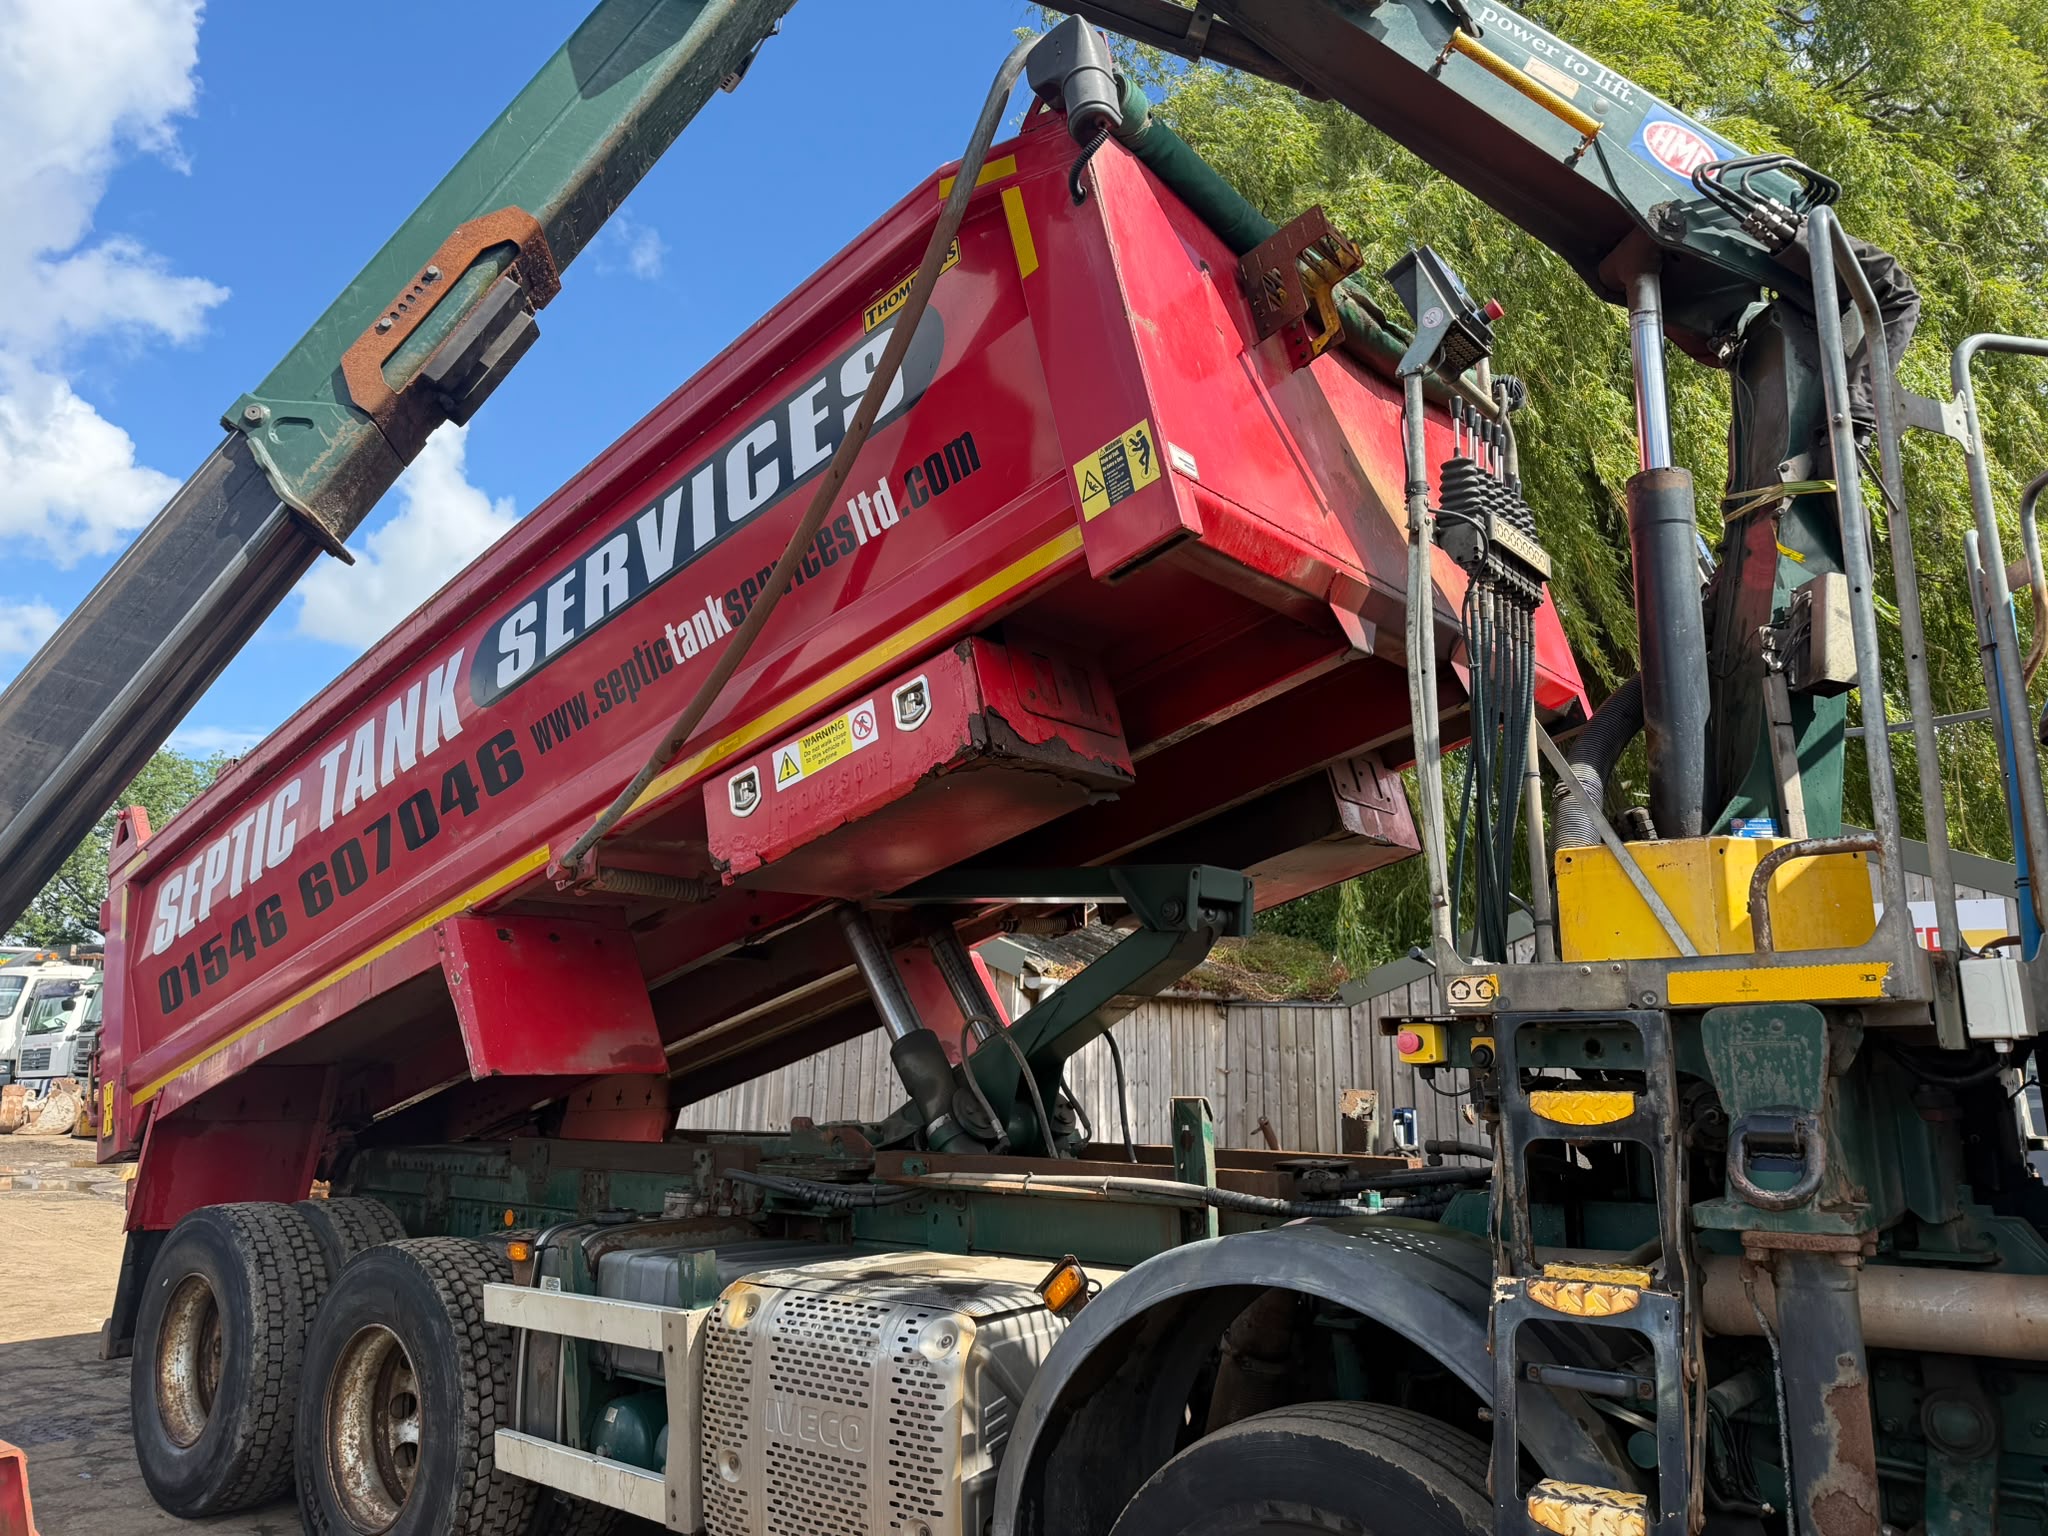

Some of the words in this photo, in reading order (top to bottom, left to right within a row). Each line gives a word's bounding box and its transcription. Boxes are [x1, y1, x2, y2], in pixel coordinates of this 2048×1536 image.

[1476, 6, 1560, 58] power
[1563, 55, 1589, 76] to
[1592, 70, 1635, 106] lift.
[153, 778, 302, 956] SEPTIC
[319, 647, 465, 833] TANK
[497, 327, 905, 689] SERVICES
[803, 720, 845, 749] WARNING
[812, 745, 820, 753] not
[833, 731, 847, 741] close
[822, 742, 840, 755] vehicle
[818, 750, 837, 764] anytime
[158, 893, 289, 1016] 01546
[298, 728, 525, 919] 607046
[765, 1397, 865, 1453] IVECO
